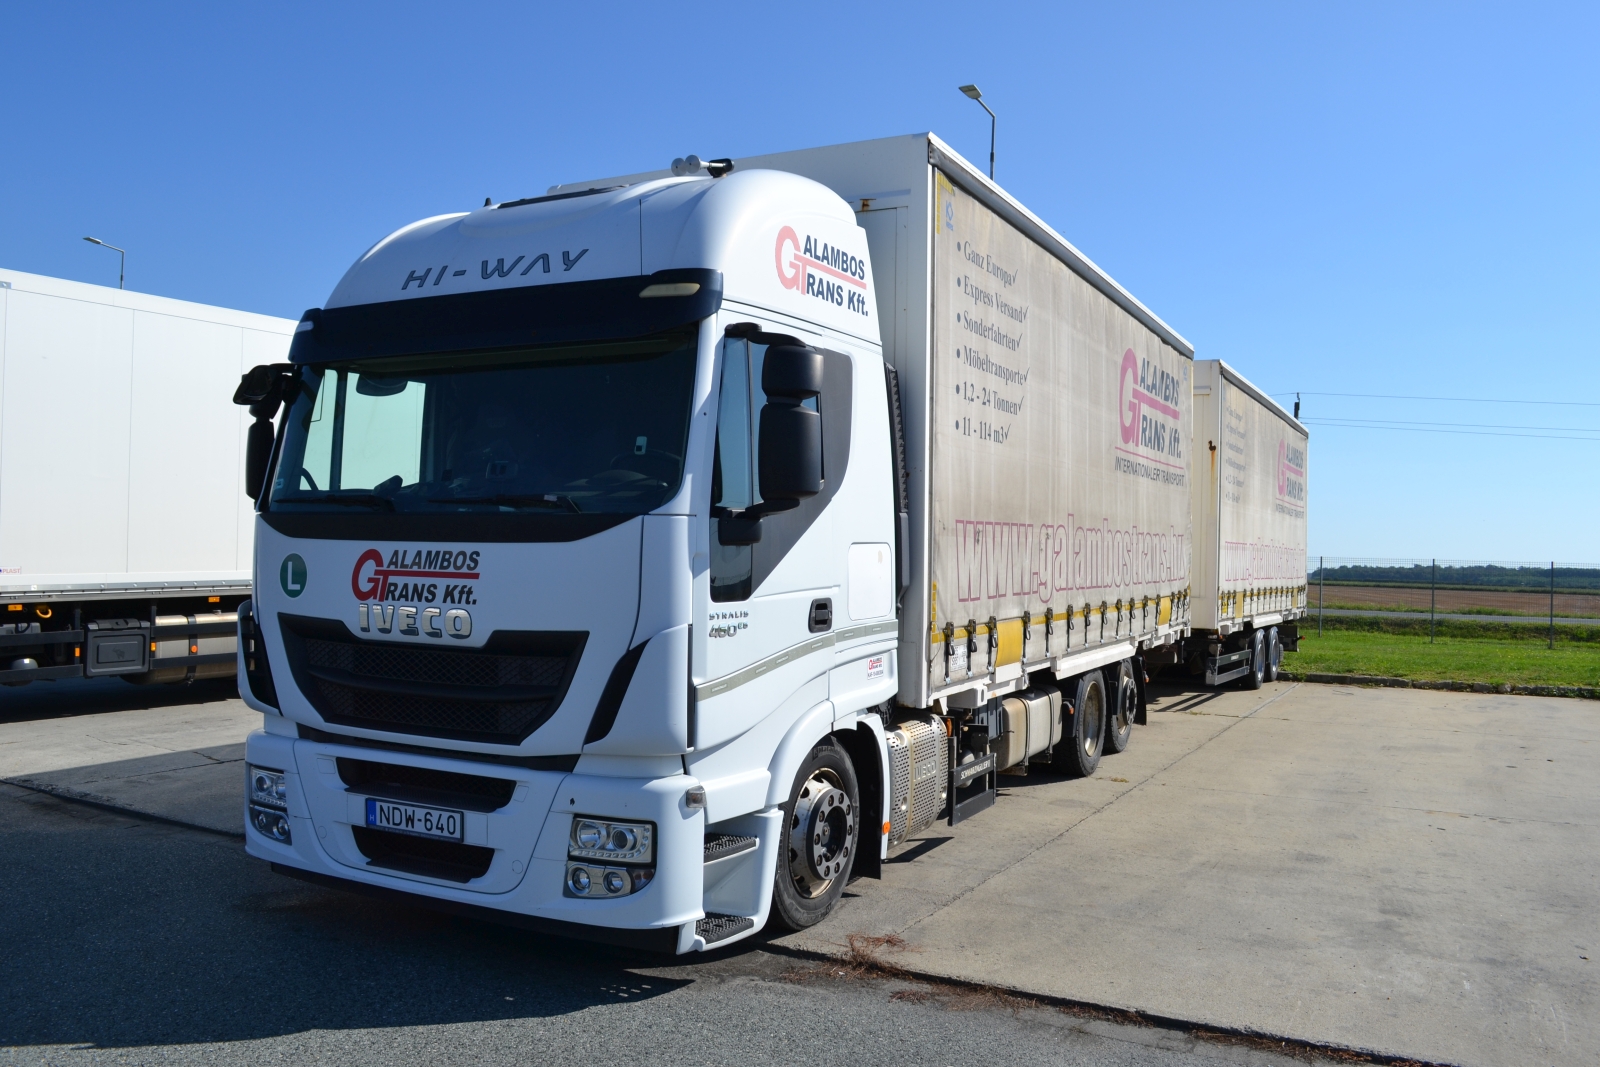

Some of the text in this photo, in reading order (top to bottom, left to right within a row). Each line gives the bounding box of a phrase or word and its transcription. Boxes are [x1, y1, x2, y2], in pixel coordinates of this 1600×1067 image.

[401, 249, 589, 290] HI-WAY
[963, 240, 1012, 288] Ganz Europa
[847, 289, 869, 317] Kft.
[963, 274, 1023, 323] Express Versand
[963, 310, 1016, 351] Sonderfahrten
[963, 345, 1024, 386] Möbeltransporte
[963, 381, 975, 405] 1,2
[982, 386, 991, 407] 24
[992, 390, 1018, 416] Tonnen
[962, 416, 971, 437] 11
[979, 420, 991, 442] 114
[1168, 426, 1182, 459] Kft.
[287, 560, 301, 591] L
[955, 513, 1186, 604] www.galambostrans.hu
[442, 584, 478, 606] Kft.
[358, 603, 473, 640] IVECO
[709, 610, 749, 621] STRALIS
[379, 804, 457, 836] NDW-640
